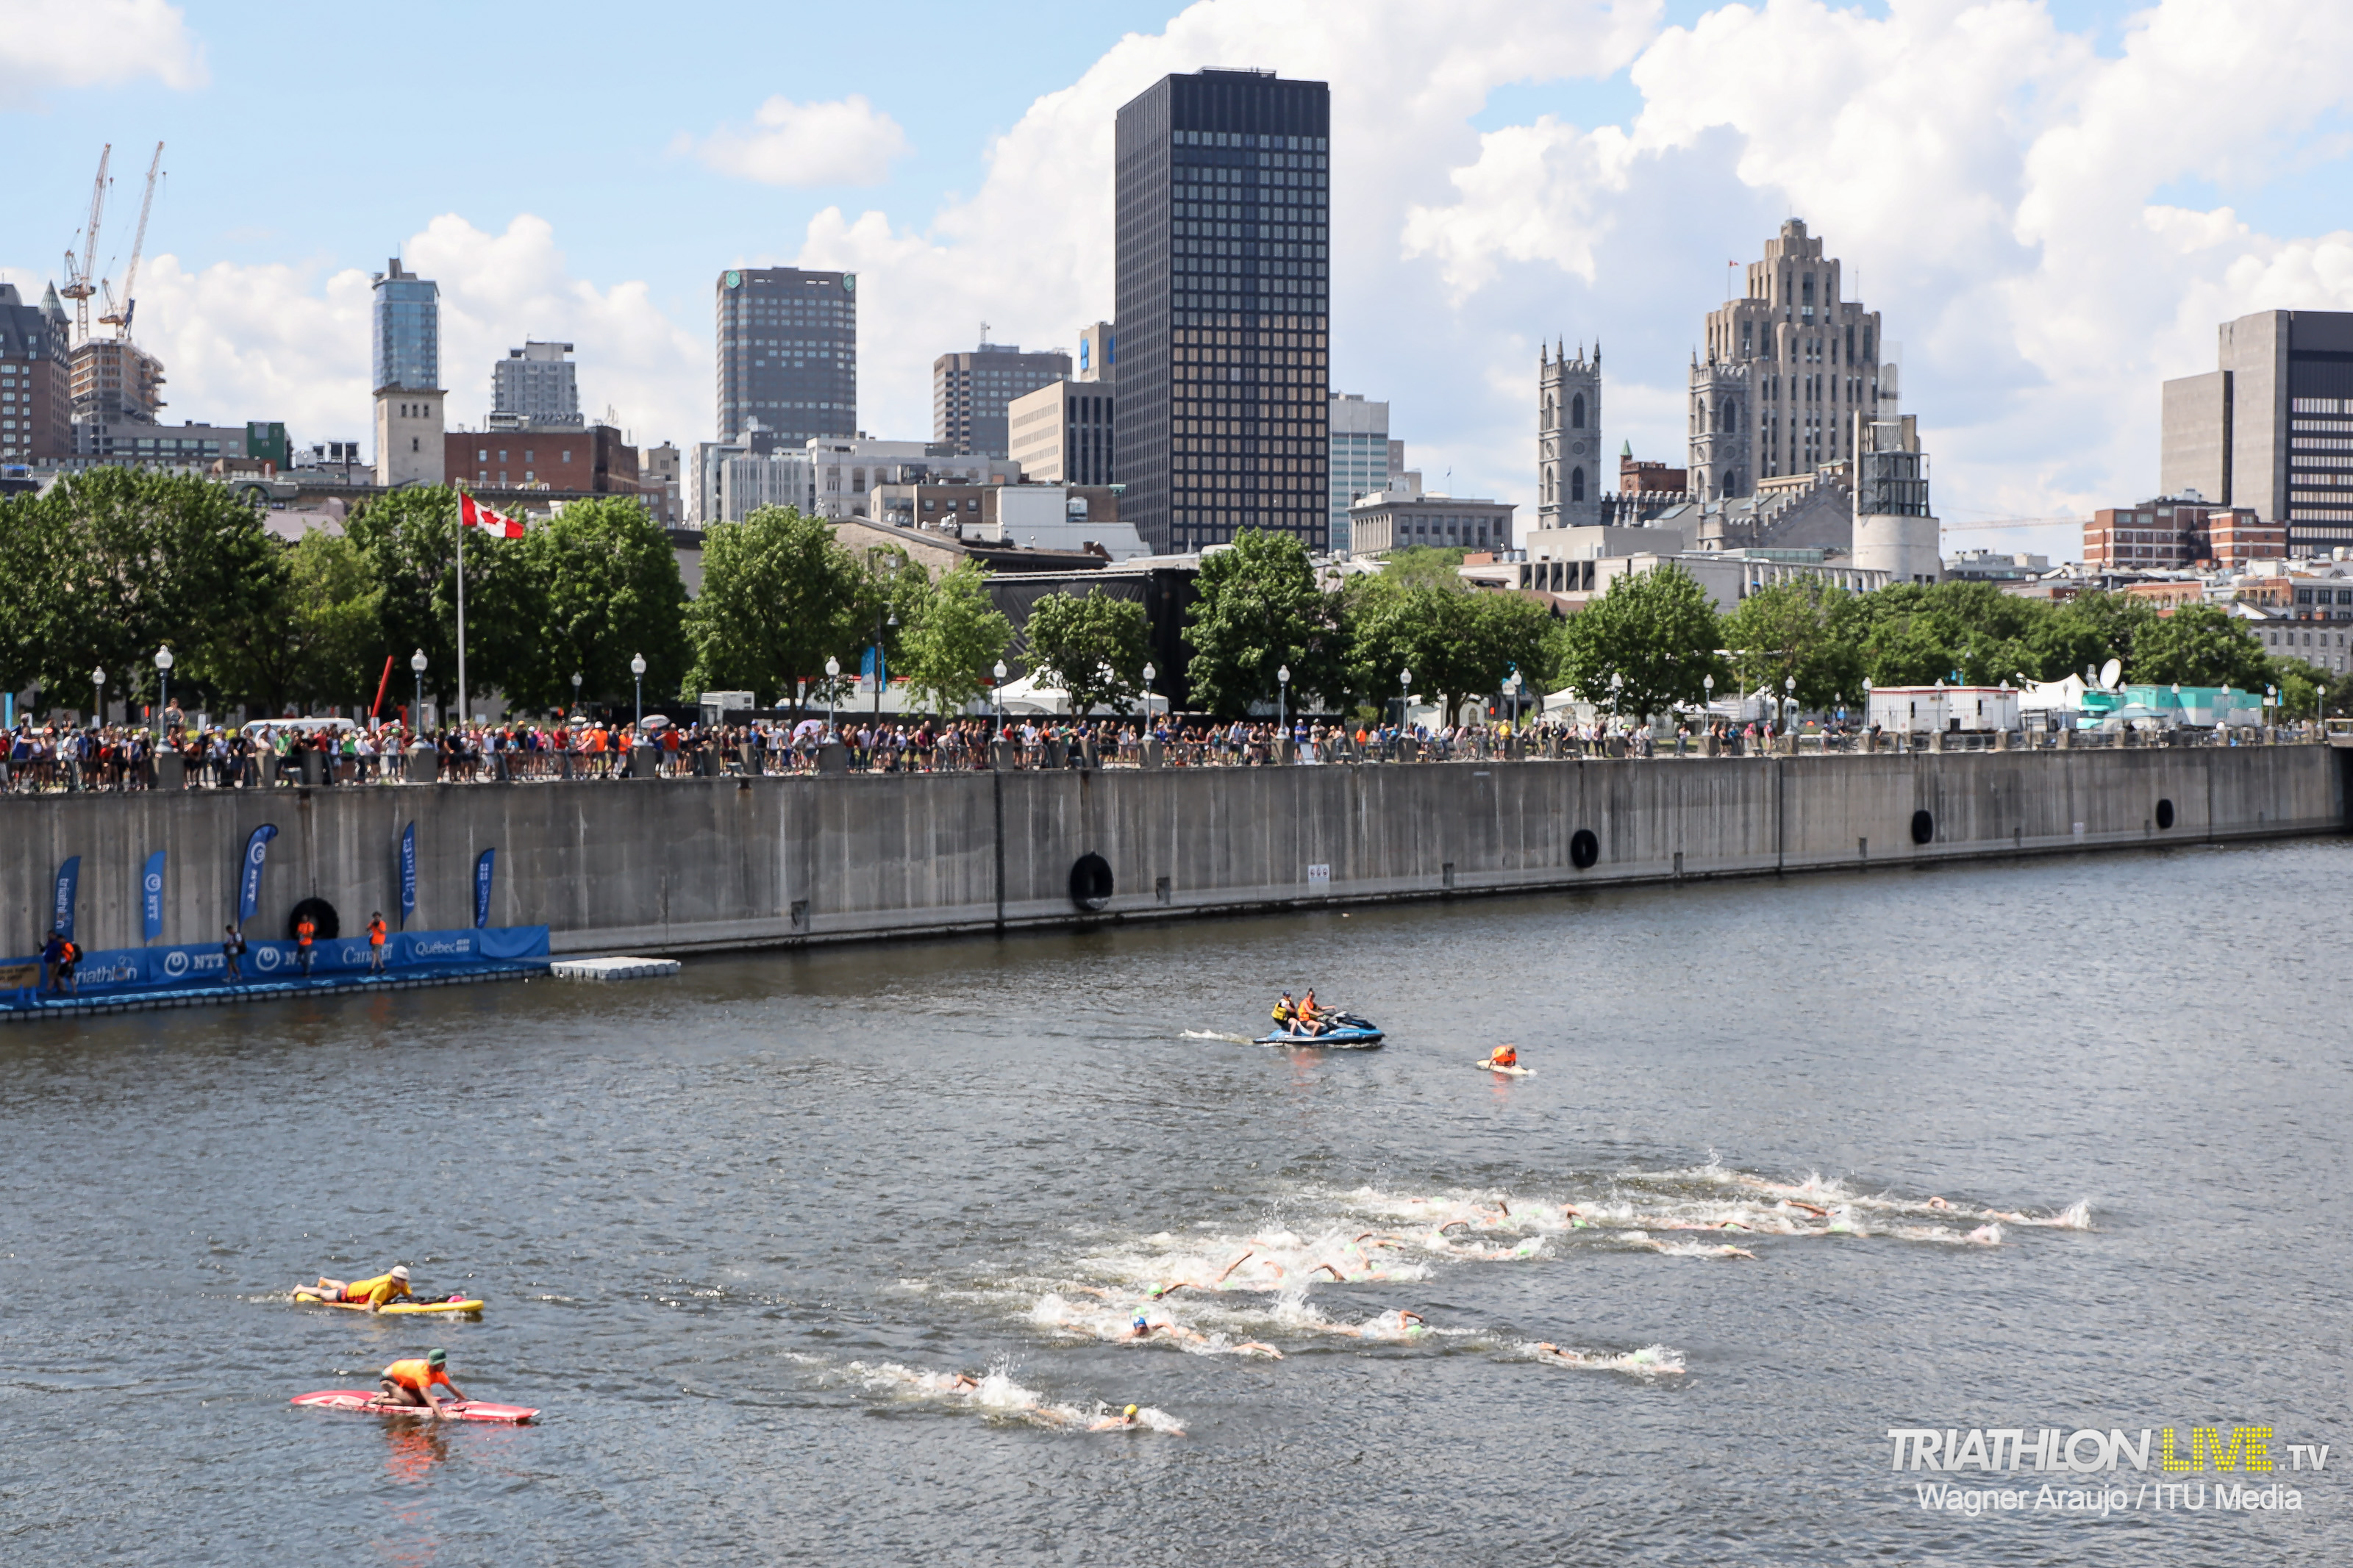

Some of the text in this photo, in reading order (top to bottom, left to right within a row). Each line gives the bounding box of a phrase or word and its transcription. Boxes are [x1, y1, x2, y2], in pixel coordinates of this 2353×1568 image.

[56, 878, 69, 929] triathlon
[147, 895, 159, 921] NTT
[415, 940, 457, 957] Québec
[193, 953, 224, 970] NTT
[75, 965, 138, 985] riathlon
